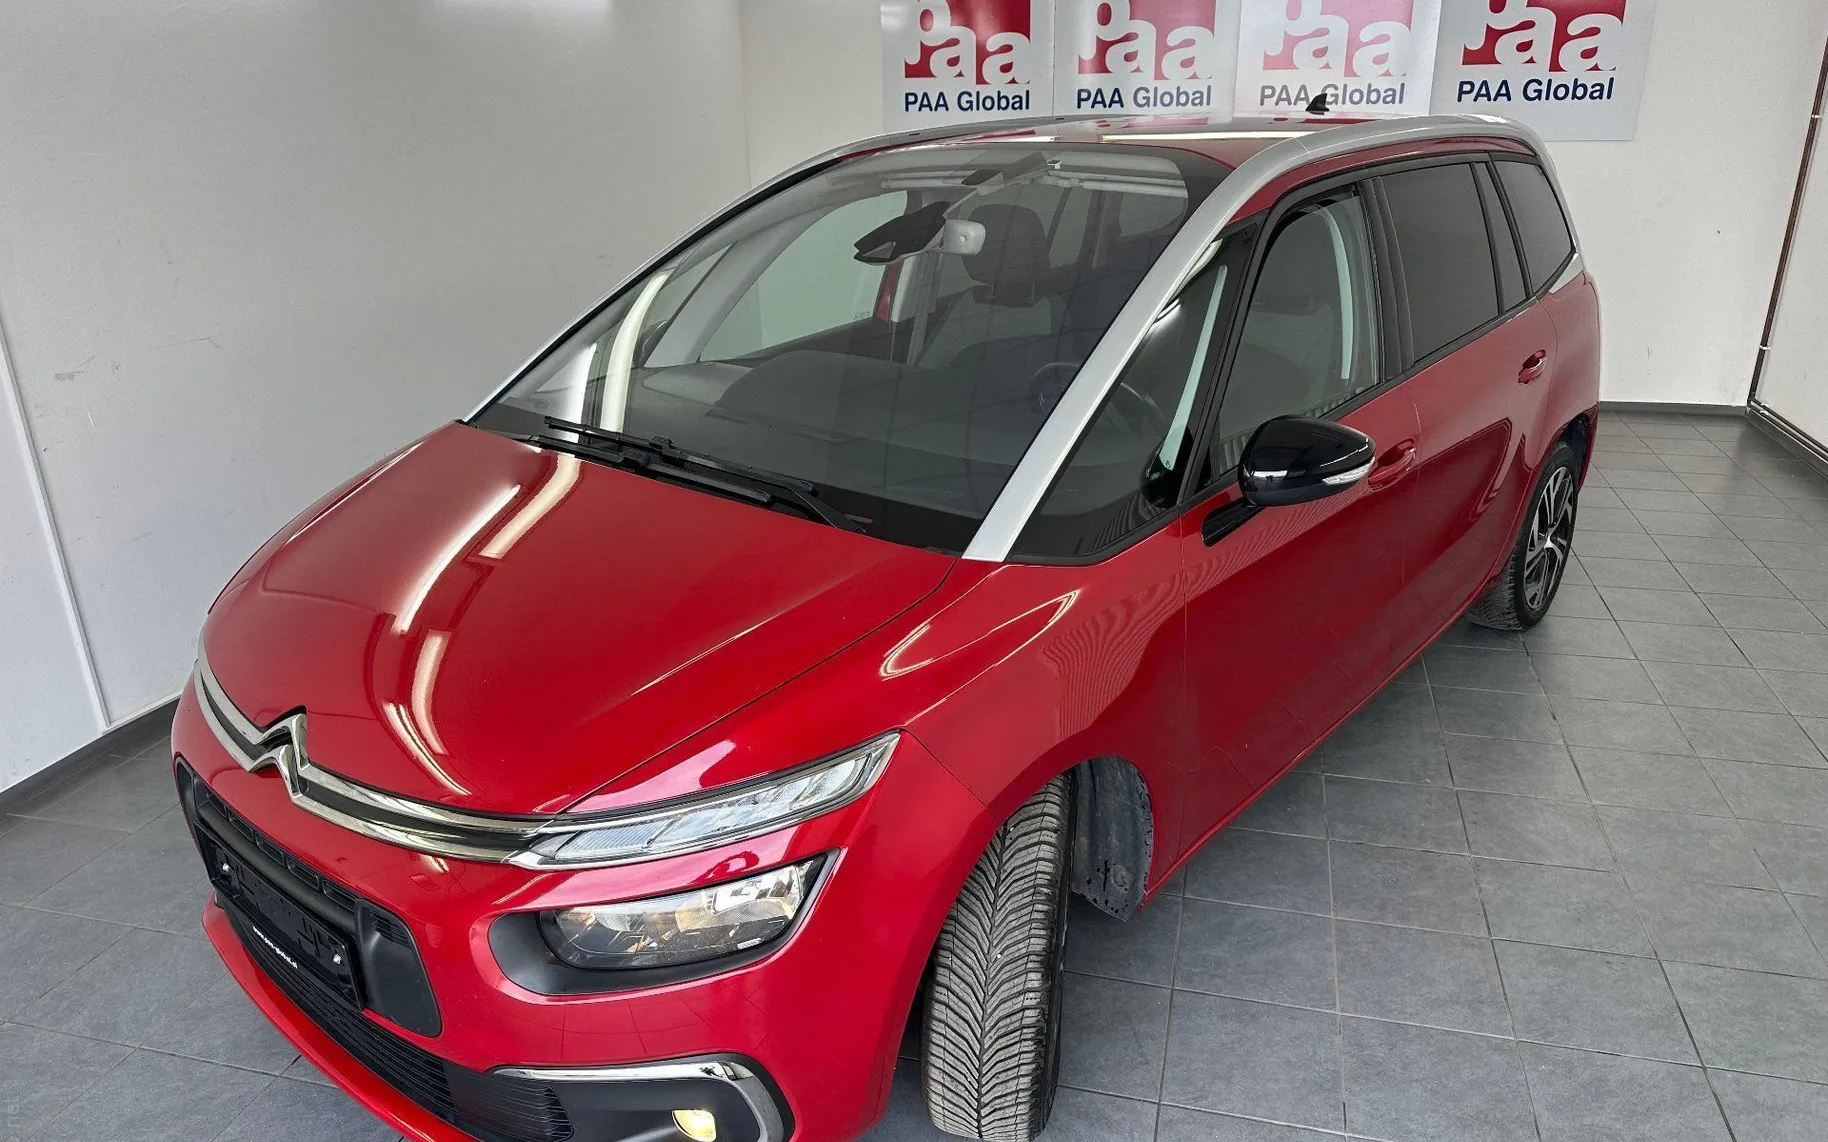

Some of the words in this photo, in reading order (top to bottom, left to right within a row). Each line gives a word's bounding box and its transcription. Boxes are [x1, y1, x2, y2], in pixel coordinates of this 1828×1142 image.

[904, 91, 950, 112] PAA
[957, 89, 1030, 112] Global
[1076, 87, 1125, 109] PAA
[1132, 85, 1212, 108] Global
[1259, 83, 1310, 106] PAA
[1320, 82, 1406, 106] Global
[1456, 79, 1512, 102] PAA
[1522, 77, 1615, 101] Global
